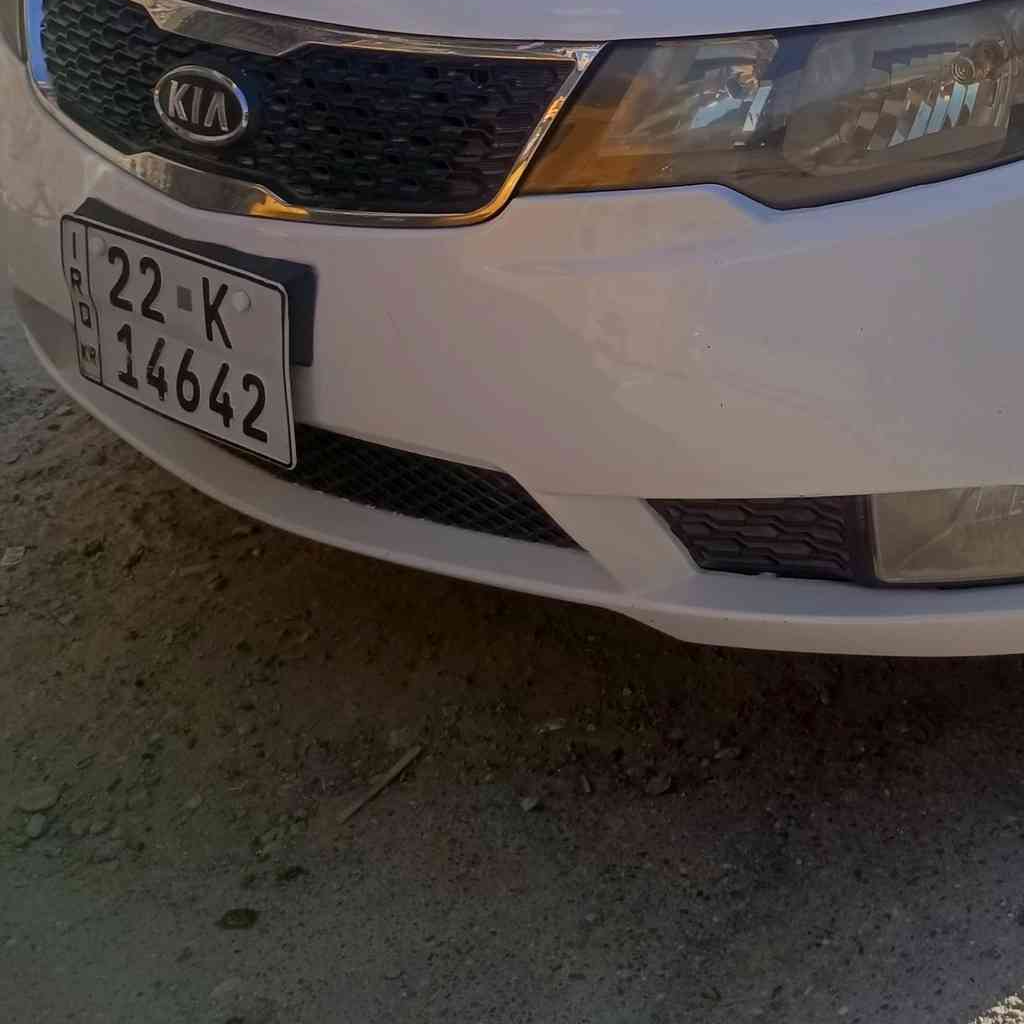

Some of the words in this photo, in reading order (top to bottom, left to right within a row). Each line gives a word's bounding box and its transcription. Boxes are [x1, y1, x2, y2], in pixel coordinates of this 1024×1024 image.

[168, 79, 229, 132] KIA
[108, 246, 166, 324] 22
[202, 276, 232, 349] K
[117, 323, 268, 443] 14642
